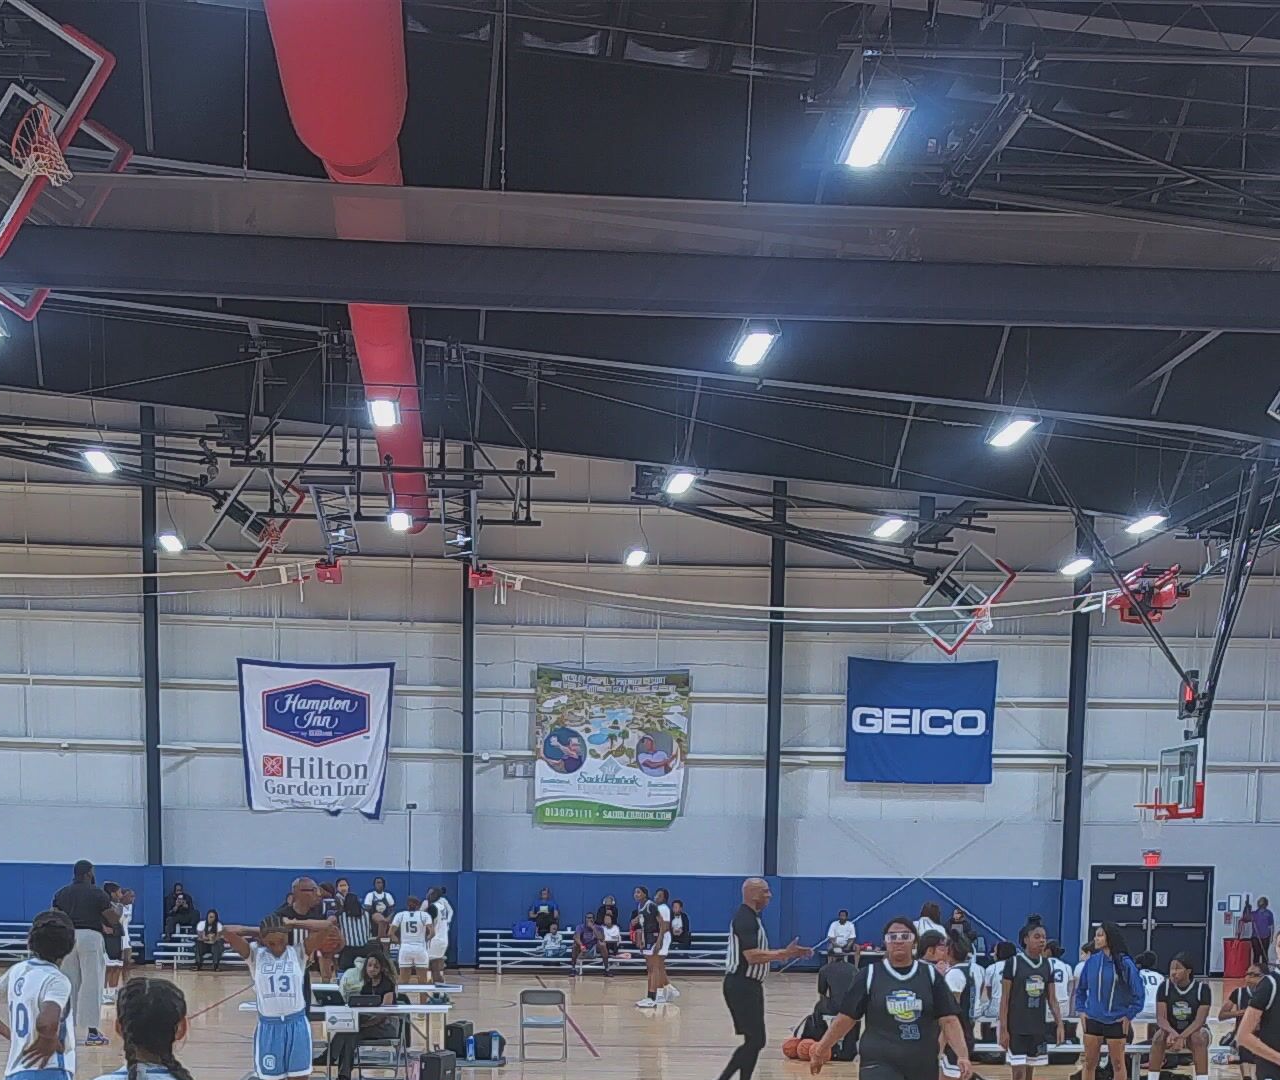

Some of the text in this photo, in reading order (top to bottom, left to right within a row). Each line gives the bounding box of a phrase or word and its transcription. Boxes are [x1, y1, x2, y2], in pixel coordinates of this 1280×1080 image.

[274, 693, 358, 715] Hampton
[294, 711, 338, 729] Inn
[852, 706, 986, 736] GEICO
[286, 756, 368, 780] Hilton
[264, 779, 367, 796] Garden Inn
[405, 920, 418, 933] 15
[269, 975, 291, 993] 13
